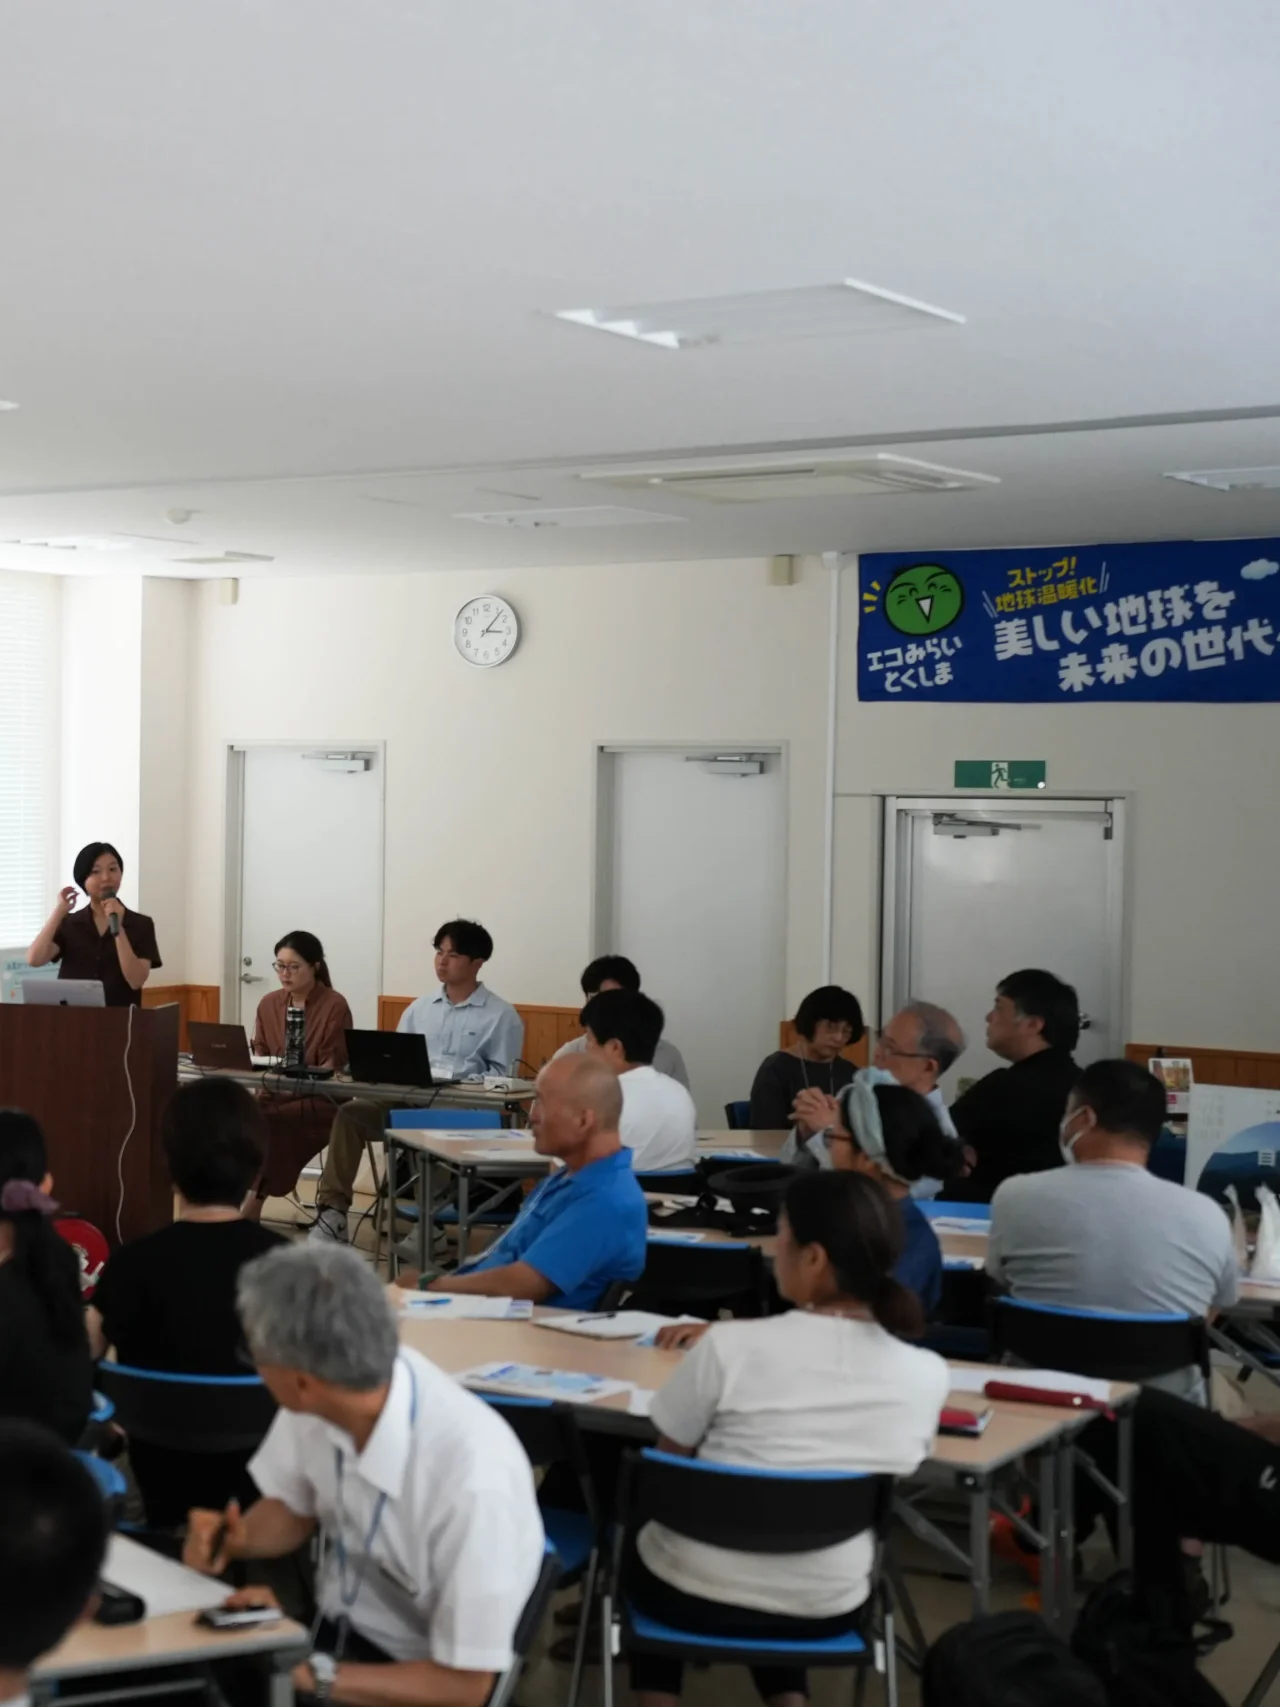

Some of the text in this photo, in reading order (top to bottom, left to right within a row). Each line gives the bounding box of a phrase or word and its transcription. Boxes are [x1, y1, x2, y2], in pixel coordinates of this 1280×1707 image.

[1006, 556, 1077, 588] ストップ!
[994, 576, 1098, 613] 地球温暖化
[993, 580, 1236, 661] 美しい地球を
[867, 636, 963, 671] エコみらい
[1057, 618, 1280, 693] 未来の世代
[884, 661, 954, 693] とくしま
